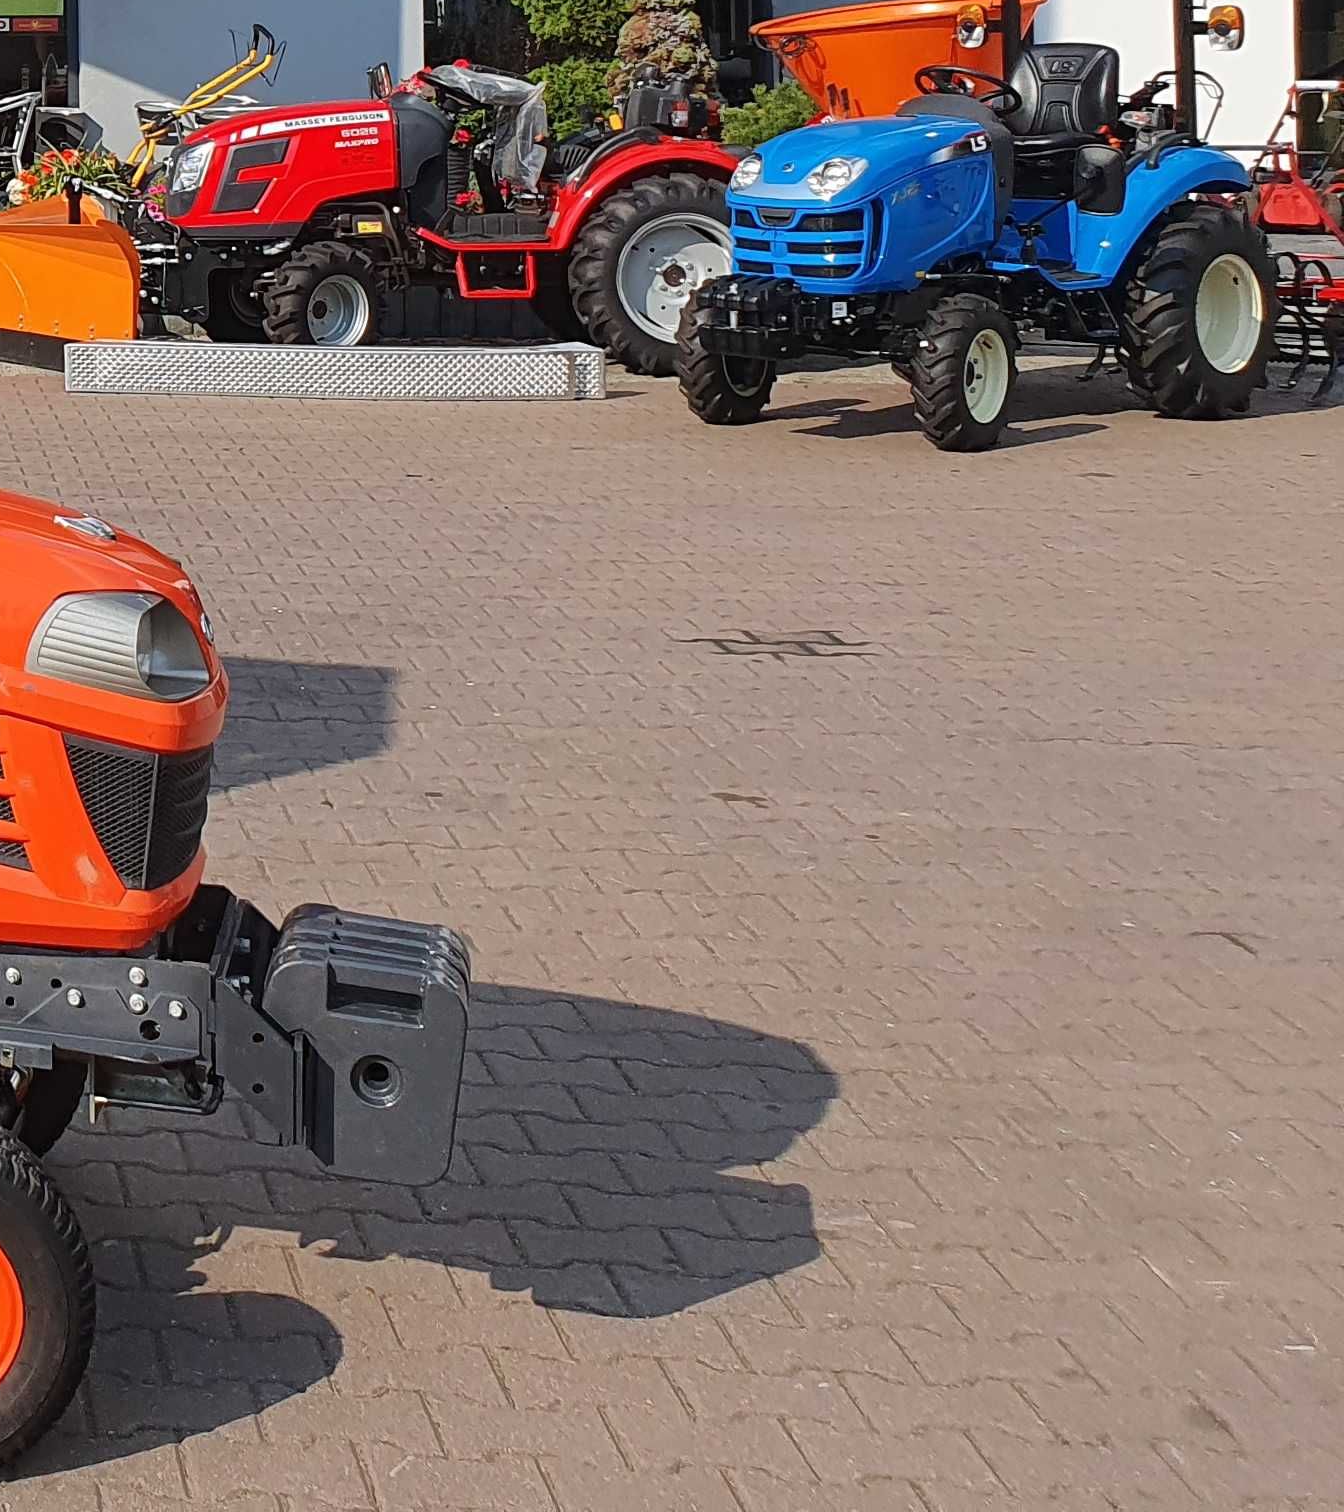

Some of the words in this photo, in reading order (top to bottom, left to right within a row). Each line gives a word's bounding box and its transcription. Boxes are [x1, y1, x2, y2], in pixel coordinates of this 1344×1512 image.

[284, 118, 326, 128] MASSEY
[329, 113, 384, 123] FERGUSON
[970, 135, 987, 153] LS
